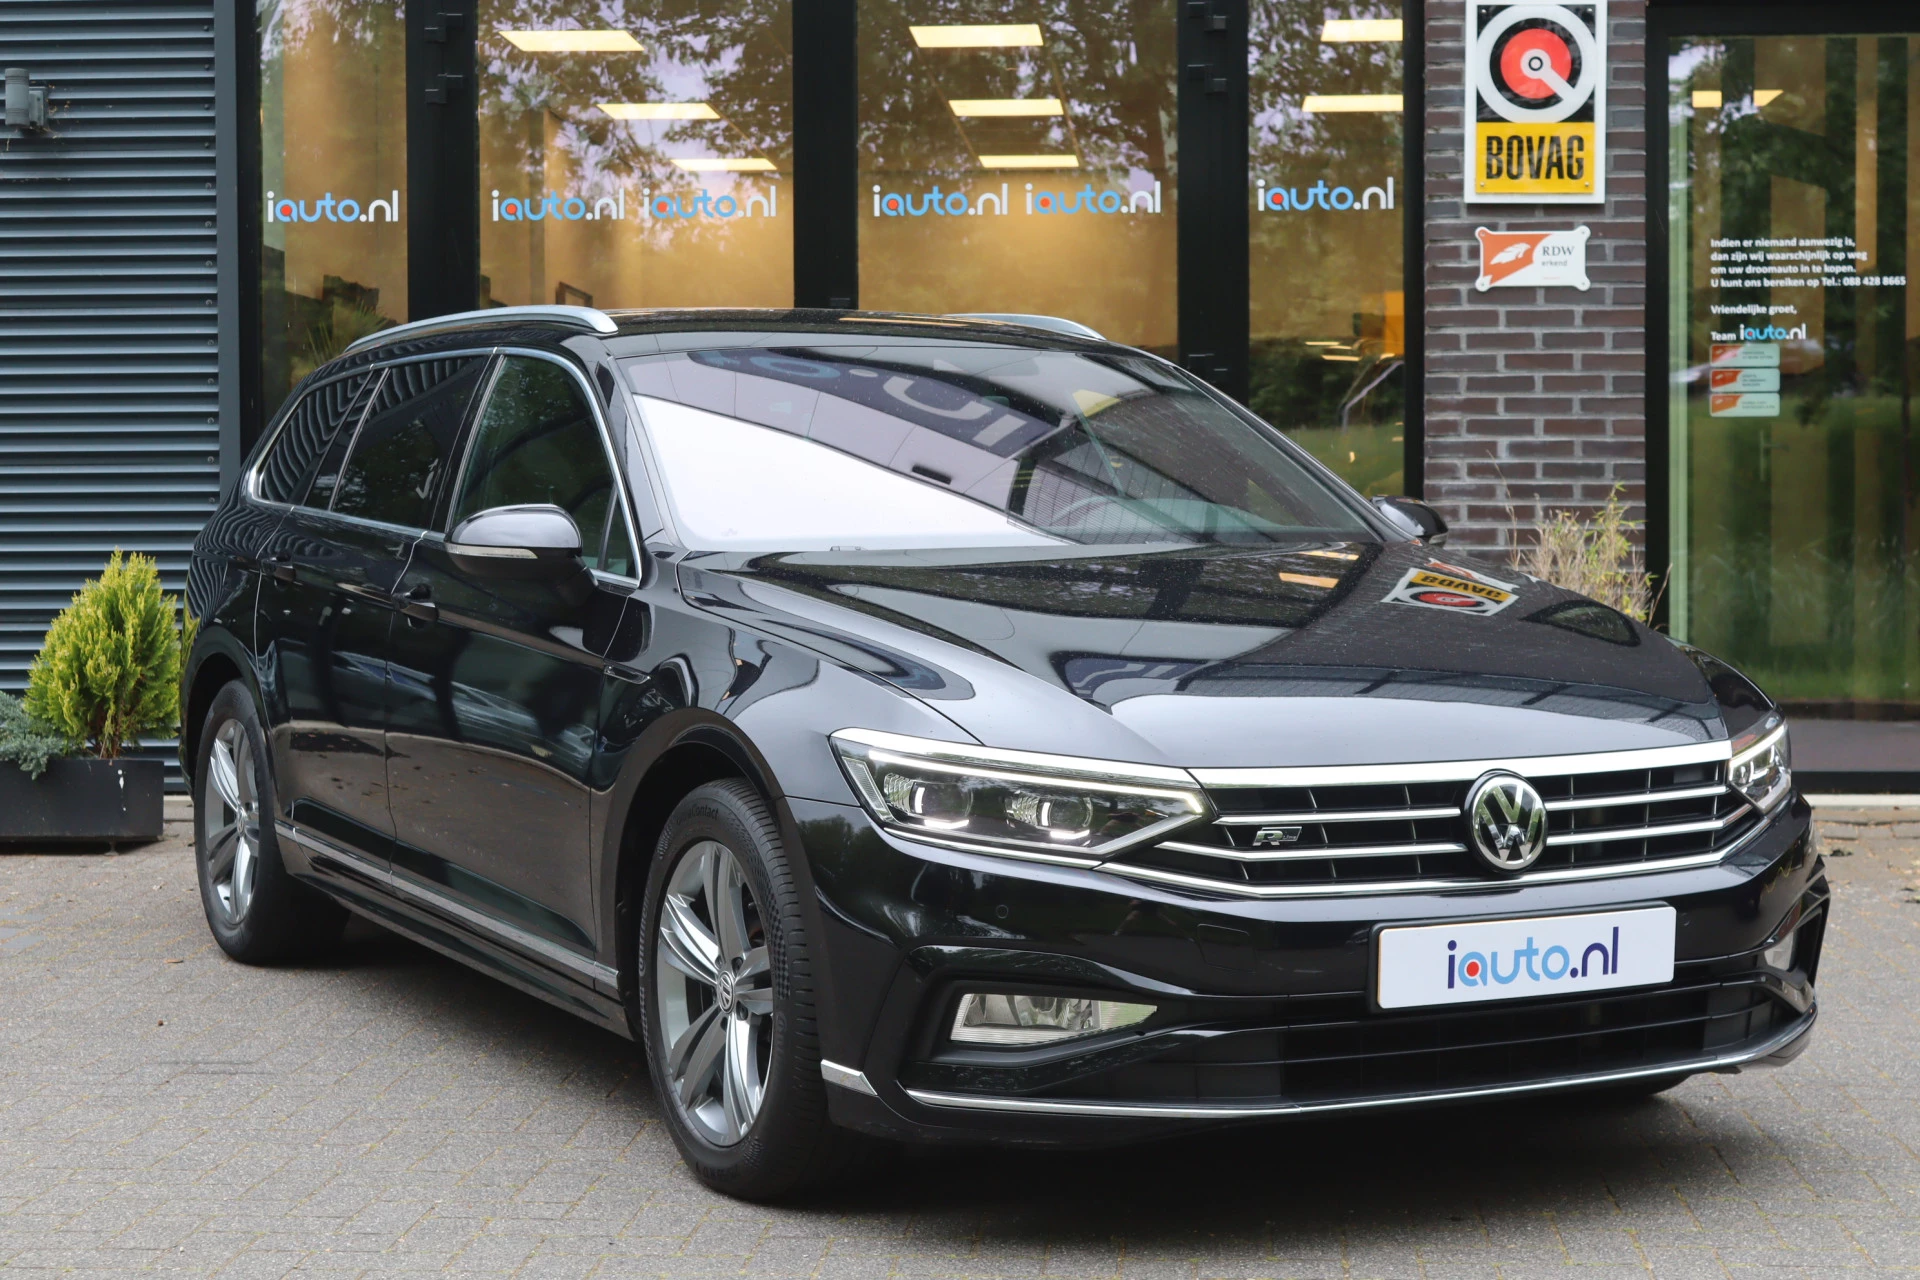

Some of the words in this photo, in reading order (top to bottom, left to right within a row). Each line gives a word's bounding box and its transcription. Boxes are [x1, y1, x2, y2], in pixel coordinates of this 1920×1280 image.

[1485, 135, 1585, 180] BOVAG
[266, 189, 399, 223] iauto.nl
[491, 188, 625, 222] iauto.nl
[642, 185, 777, 219] iauto.nl
[872, 183, 1009, 218] iauto.nl
[1025, 180, 1161, 216] iauto.nl
[1256, 176, 1394, 212] iauto.nl
[1542, 246, 1575, 256] RDW
[1710, 238, 1741, 248] Indien
[1742, 239, 1753, 248] er
[1755, 237, 1797, 247] niemand
[1798, 237, 1843, 248] aanwezig
[1844, 236, 1856, 247] is,
[1710, 251, 1729, 261] dan
[1730, 251, 1748, 262] zijn
[1749, 251, 1765, 262] wij
[1765, 250, 1831, 261] waarschijnlijk
[1832, 251, 1846, 261] op
[1847, 251, 1868, 261] weg
[1710, 266, 1727, 274] om
[1728, 266, 1744, 274] uw
[1745, 264, 1799, 274] droomauto
[1800, 264, 1810, 273] in
[1811, 264, 1822, 273] te
[1823, 263, 1856, 275] kopen.
[1710, 278, 1719, 287] U
[1720, 278, 1742, 287] kunt
[1744, 279, 1762, 287] ons
[1763, 277, 1805, 287] bereiken
[1806, 279, 1819, 288] op
[1820, 276, 1841, 286] Tel.:
[1842, 276, 1861, 286] 088
[1862, 276, 1881, 286] 428
[1882, 276, 1906, 286] 8665
[1710, 304, 1767, 316] Vriendelijke
[1768, 304, 1797, 316] groet,
[1710, 331, 1737, 341] Team
[1739, 322, 1807, 341] iauto.nl
[1446, 926, 1619, 989] iauto.nl
